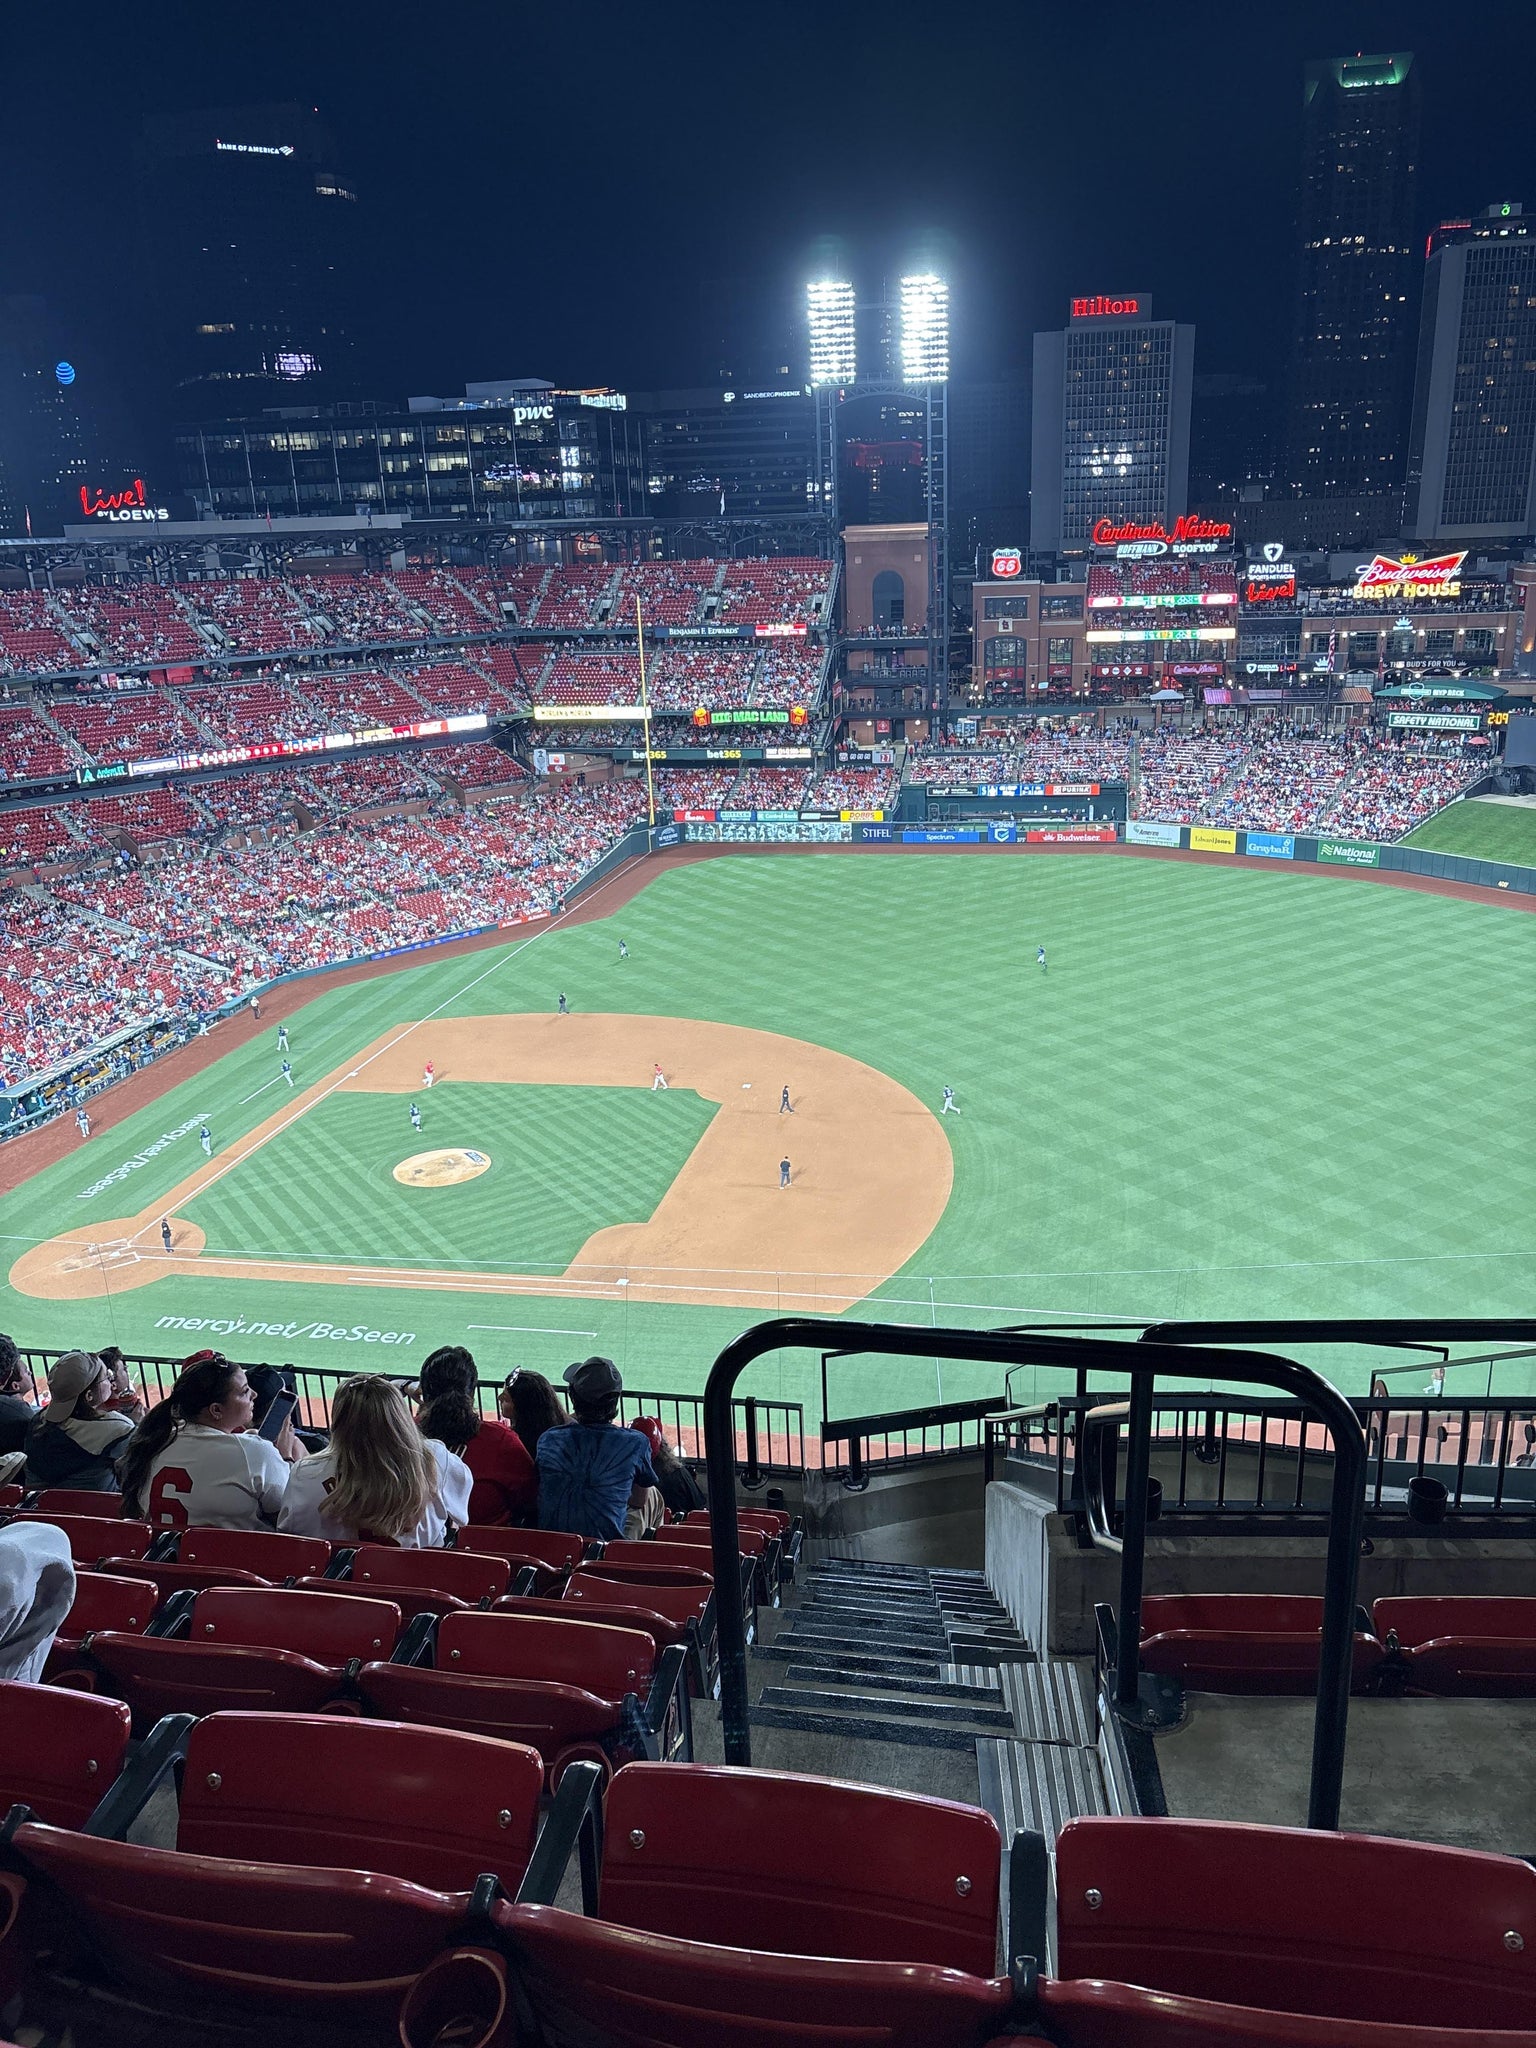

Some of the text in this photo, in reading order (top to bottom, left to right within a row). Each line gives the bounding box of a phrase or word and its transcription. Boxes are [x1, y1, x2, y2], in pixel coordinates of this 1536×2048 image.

[217, 143, 237, 151] BANK
[248, 146, 280, 155] AMERICA
[1072, 296, 1138, 317] Hilton
[513, 405, 554, 425] pwc
[81, 479, 145, 515] Live!
[109, 508, 169, 521] LOEWS
[1092, 515, 1231, 545] Cardinals Nation
[1172, 543, 1218, 553] ROOFTOP
[996, 560, 1016, 572] 66
[1248, 563, 1296, 574] FANDUEL
[1355, 563, 1462, 583] Budweiser
[1353, 581, 1461, 599] BREW HOUSE
[708, 627, 738, 635] EDWARDS
[1406, 660, 1427, 668] BUD'S
[1442, 659, 1457, 667] YOU
[733, 712, 760, 723] MAC
[759, 711, 790, 723] LAND
[1392, 715, 1475, 728] SAFETY NATIONAL
[1487, 713, 1509, 725] 2:09
[706, 749, 741, 759] bet365
[862, 828, 892, 838] STIFEL
[1139, 829, 1160, 837] Ameren
[77, 1113, 213, 1199] mercy.net/BeSeen
[154, 1314, 417, 1345] mercy.net/BeSeen
[149, 1466, 194, 1526] 6
